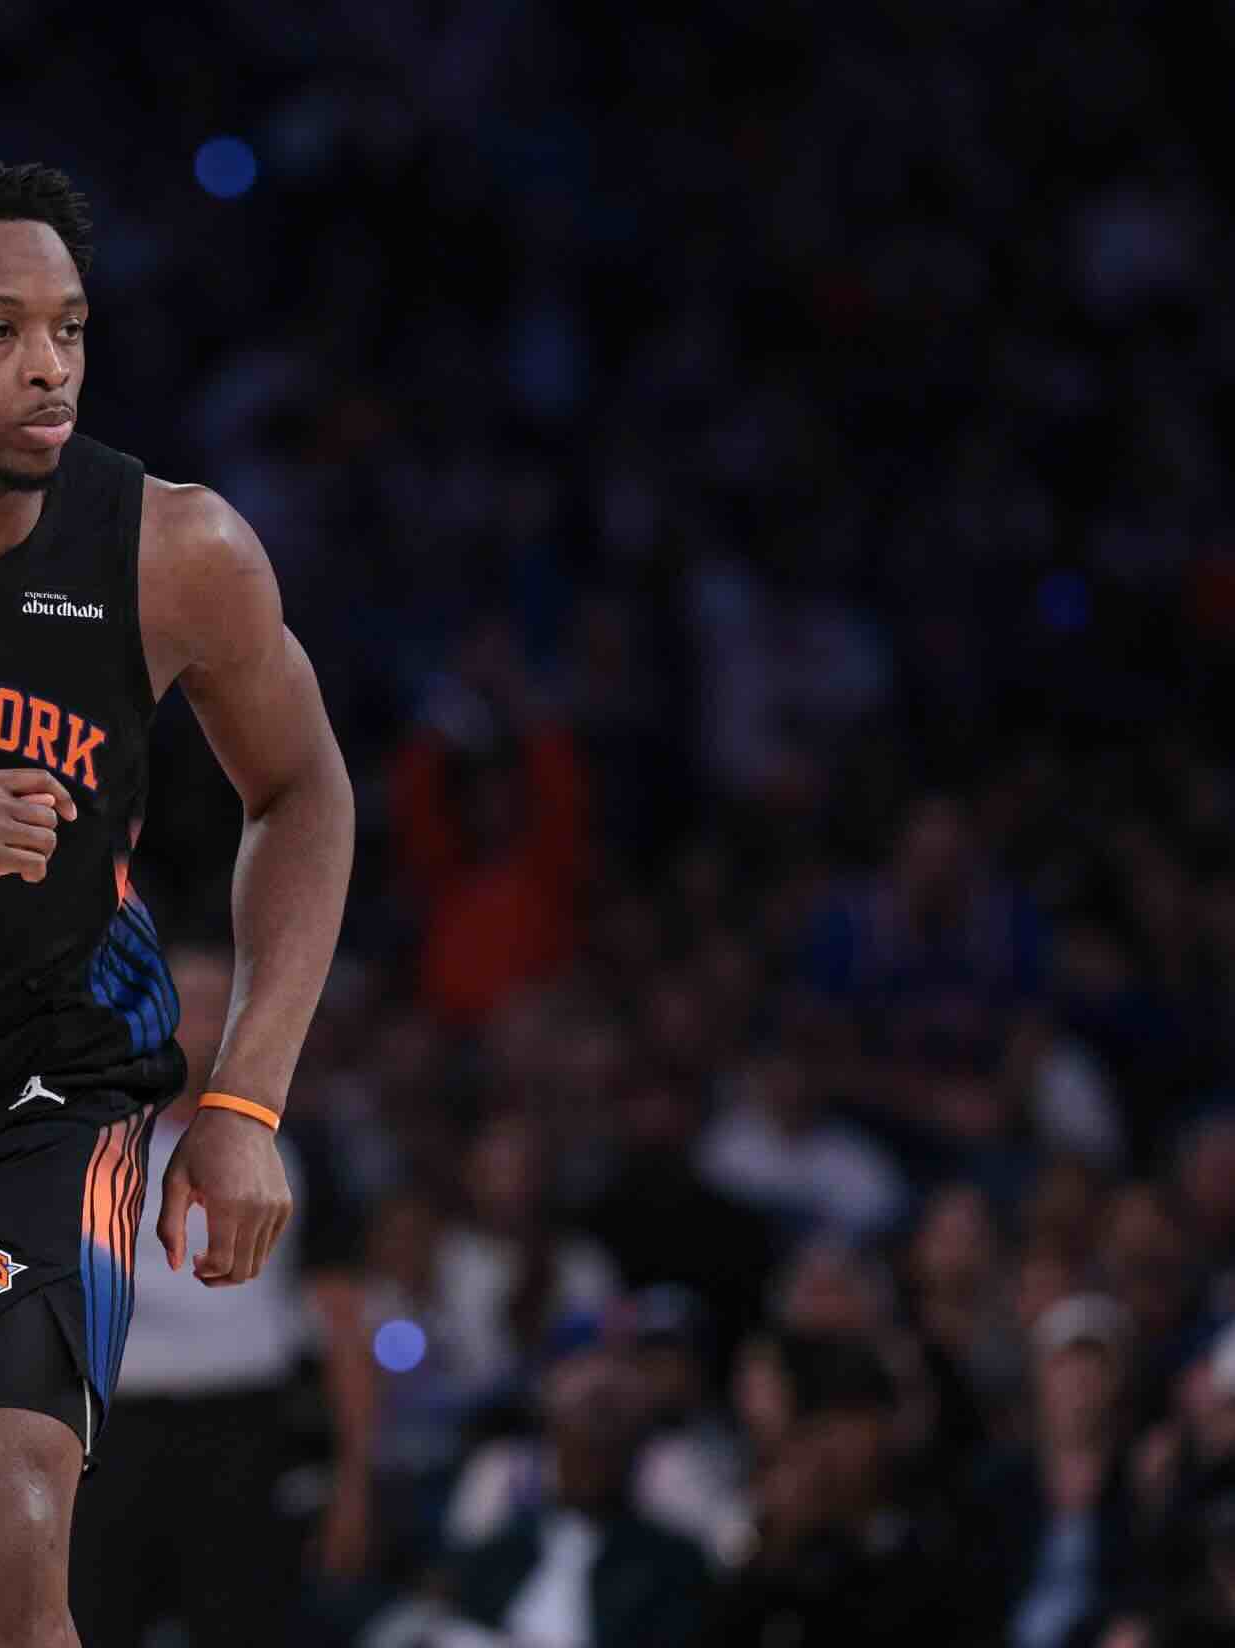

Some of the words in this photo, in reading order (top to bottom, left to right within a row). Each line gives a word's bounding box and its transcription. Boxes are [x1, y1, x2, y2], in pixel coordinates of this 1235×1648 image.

[24, 591, 68, 600] experience
[22, 600, 54, 615] abu
[56, 602, 104, 619] dhabi
